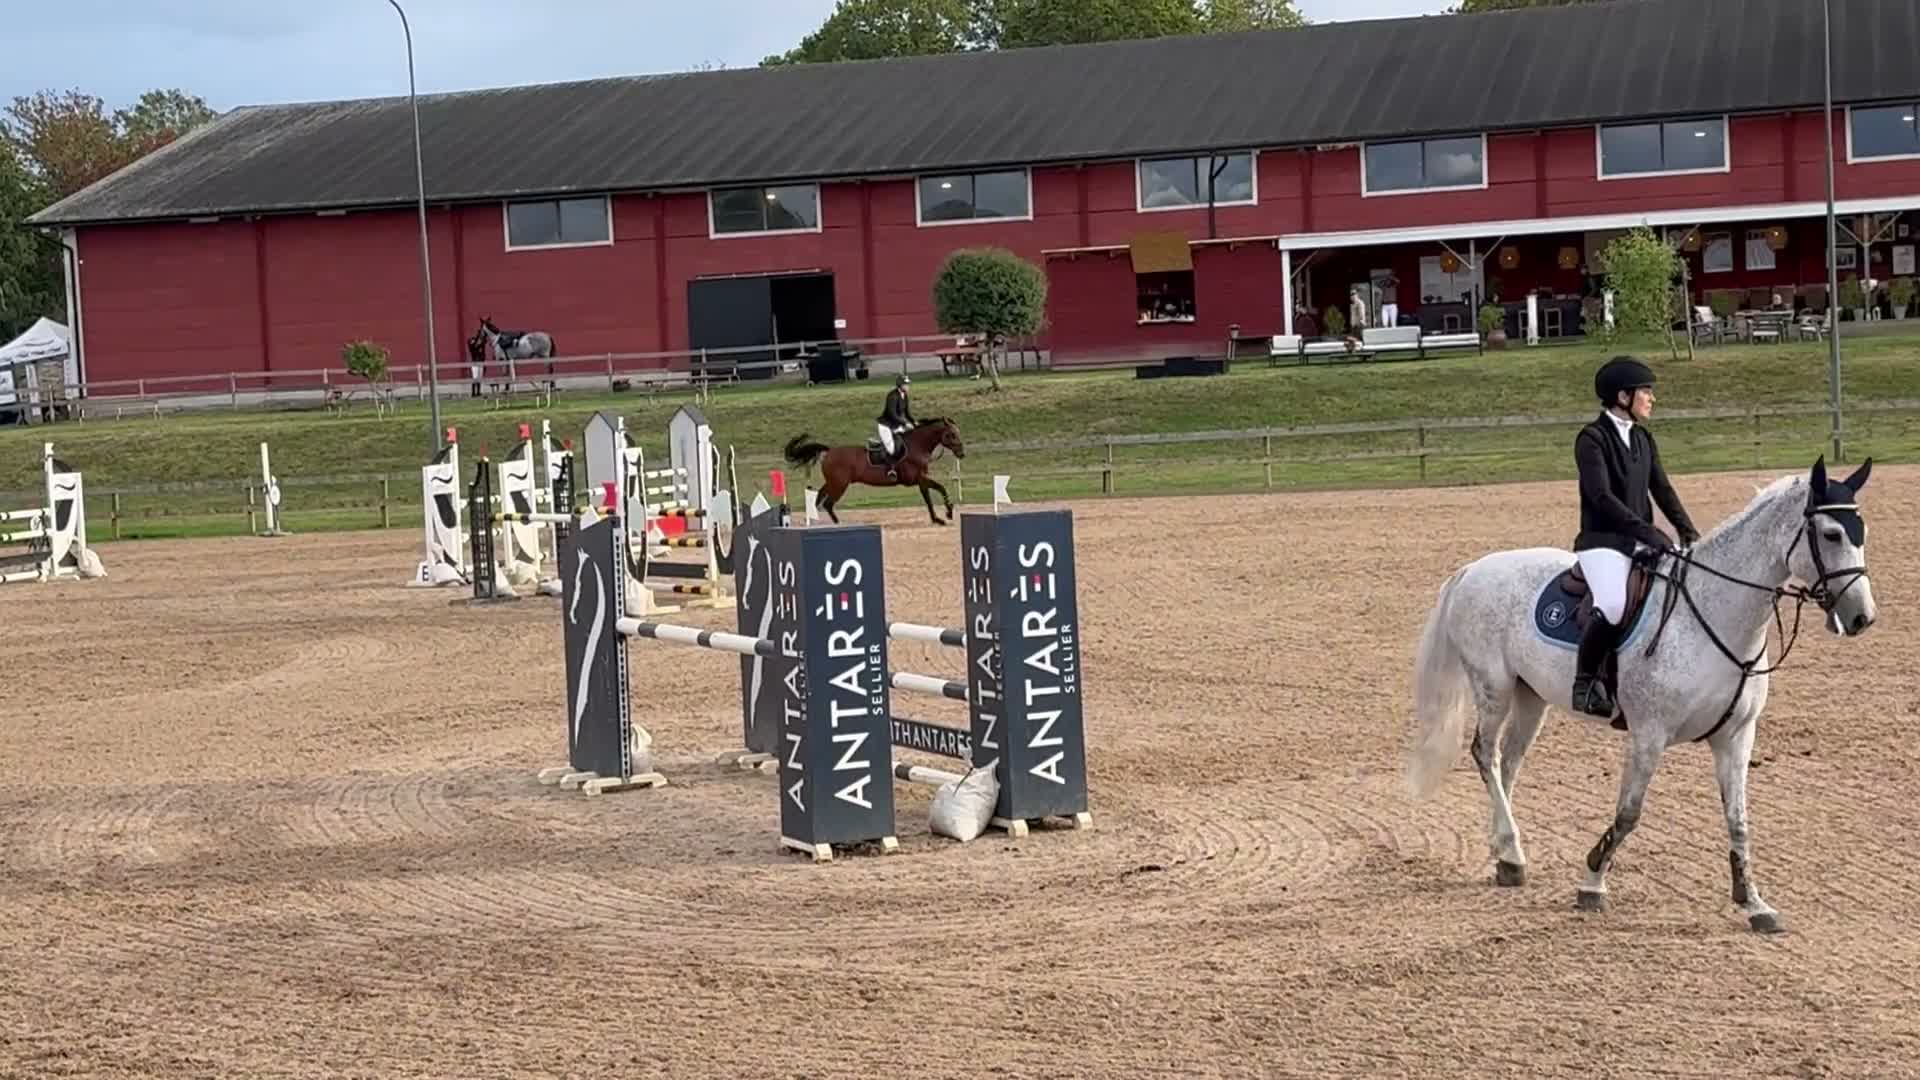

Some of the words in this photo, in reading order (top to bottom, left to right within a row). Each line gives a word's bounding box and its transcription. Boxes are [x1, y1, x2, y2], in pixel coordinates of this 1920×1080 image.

[422, 565, 430, 582] E
[777, 560, 806, 812] ANTARÈS
[816, 558, 873, 809] ANTARÈS
[871, 643, 884, 716] SELLIER
[1010, 541, 1066, 785] ANTARÈS
[1061, 623, 1076, 694] SELLIER
